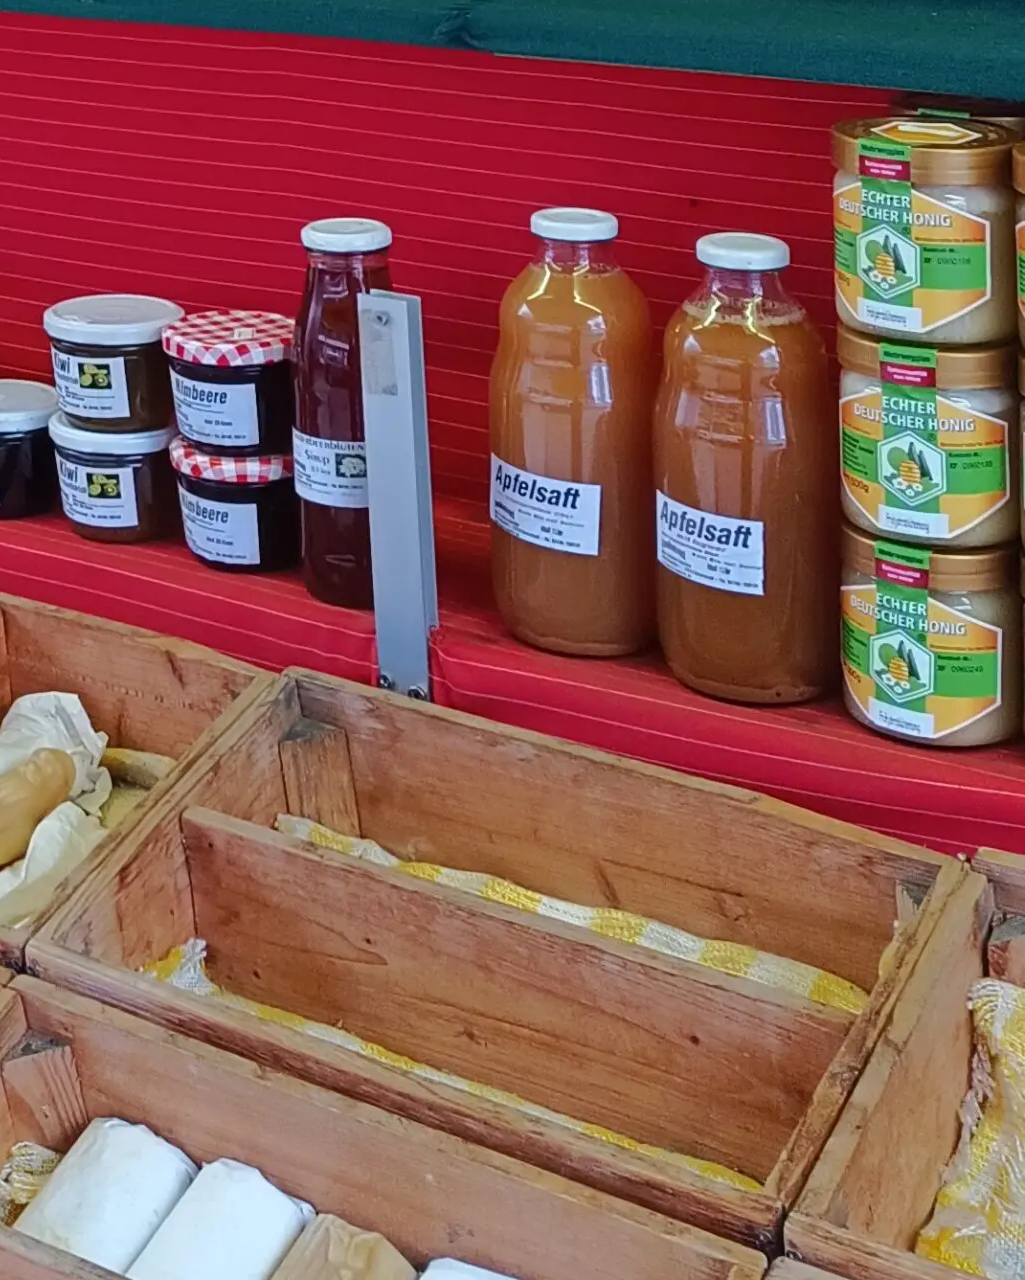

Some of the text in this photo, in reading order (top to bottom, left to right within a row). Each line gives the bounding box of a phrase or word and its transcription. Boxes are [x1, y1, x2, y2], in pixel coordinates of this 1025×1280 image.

[838, 196, 952, 228] DEUTSCHER HONIG
[861, 188, 912, 209] ECHTER
[53, 350, 72, 375] Kiwi
[854, 402, 976, 433] DEUTSCHER HONIG
[882, 395, 937, 416] ECHTER
[59, 458, 79, 483] Kiwi
[495, 464, 581, 510] Apfelsaft
[659, 499, 753, 550] Apfelsaft
[850, 594, 968, 636] DEUTSCHER HONIG
[876, 592, 928, 616] ECHTER
